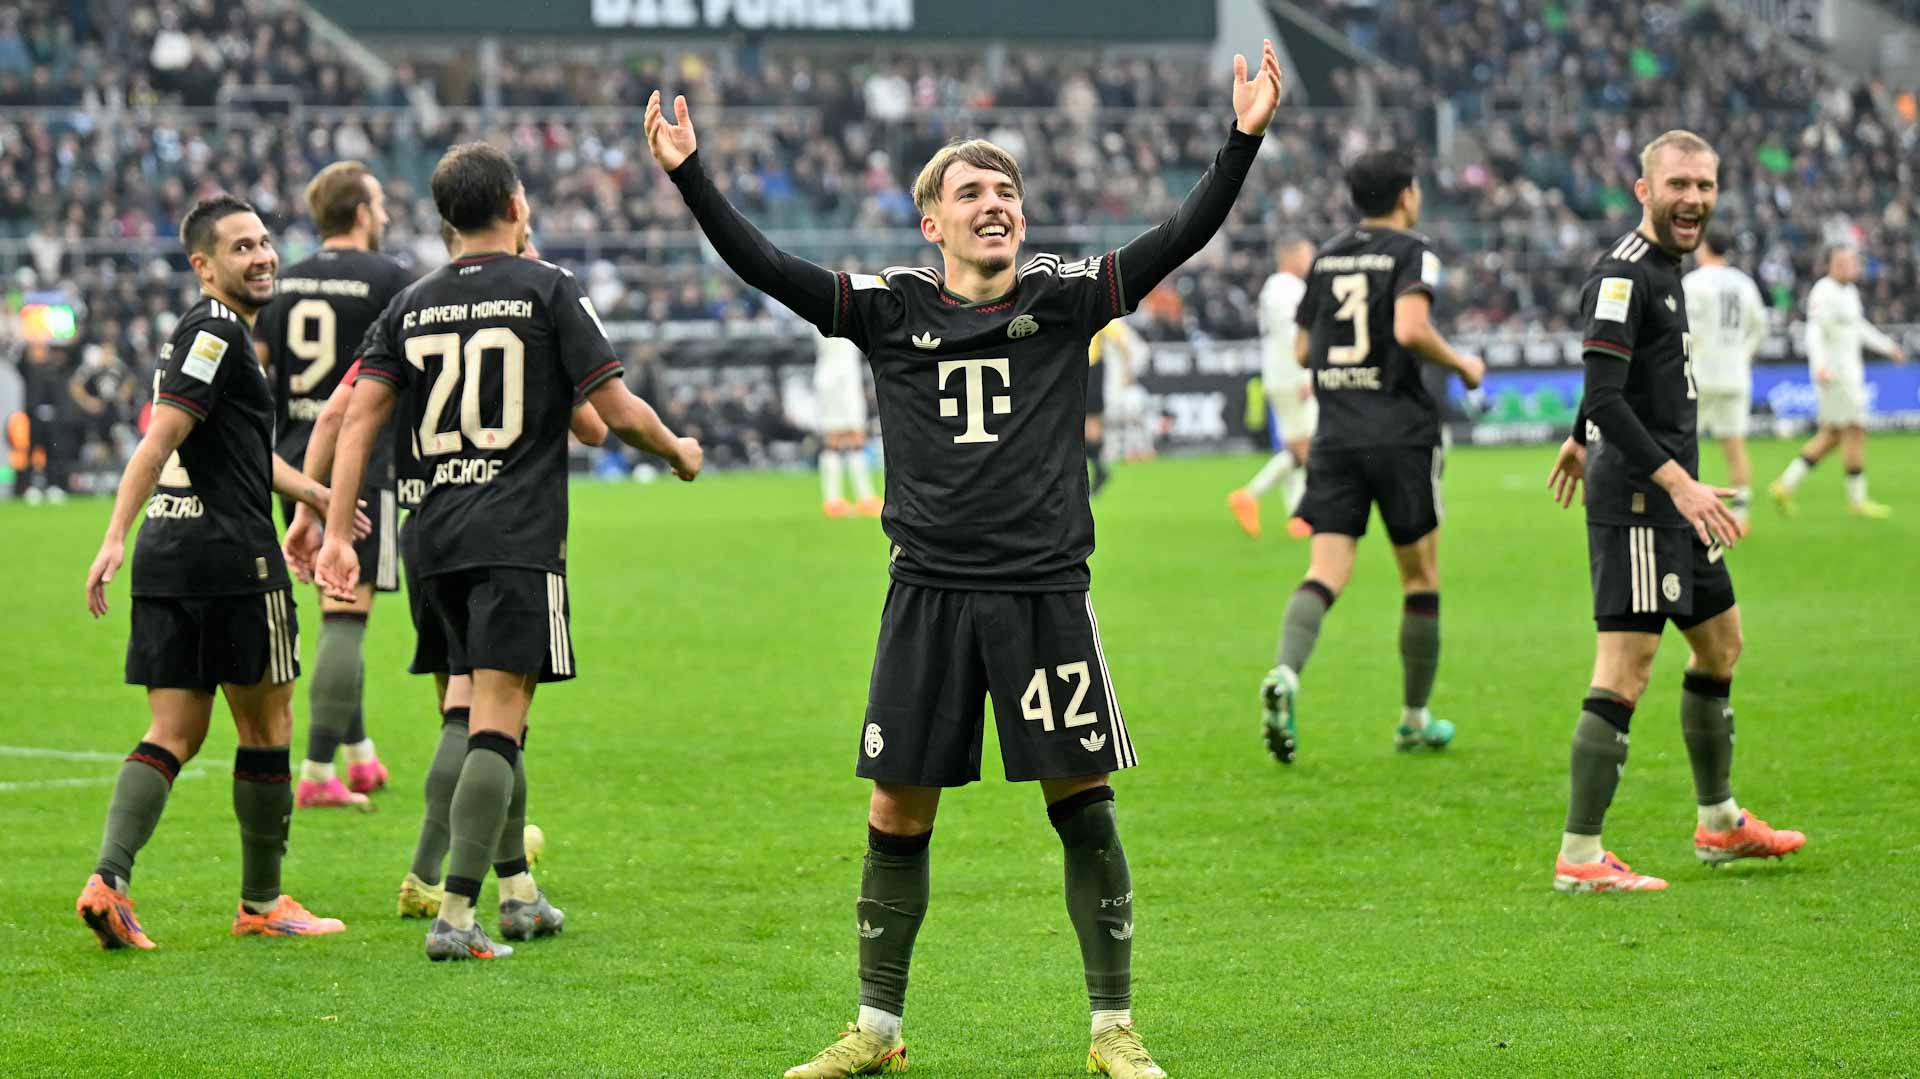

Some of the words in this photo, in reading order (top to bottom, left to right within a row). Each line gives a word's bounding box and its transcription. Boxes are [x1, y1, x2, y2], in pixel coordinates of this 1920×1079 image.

[287, 299, 336, 393] 9
[402, 311, 417, 330] FC
[419, 304, 467, 326] BAYERN
[1327, 272, 1370, 365] 3
[405, 327, 525, 457] 20
[938, 357, 1011, 444] T
[1020, 660, 1098, 732] 42
